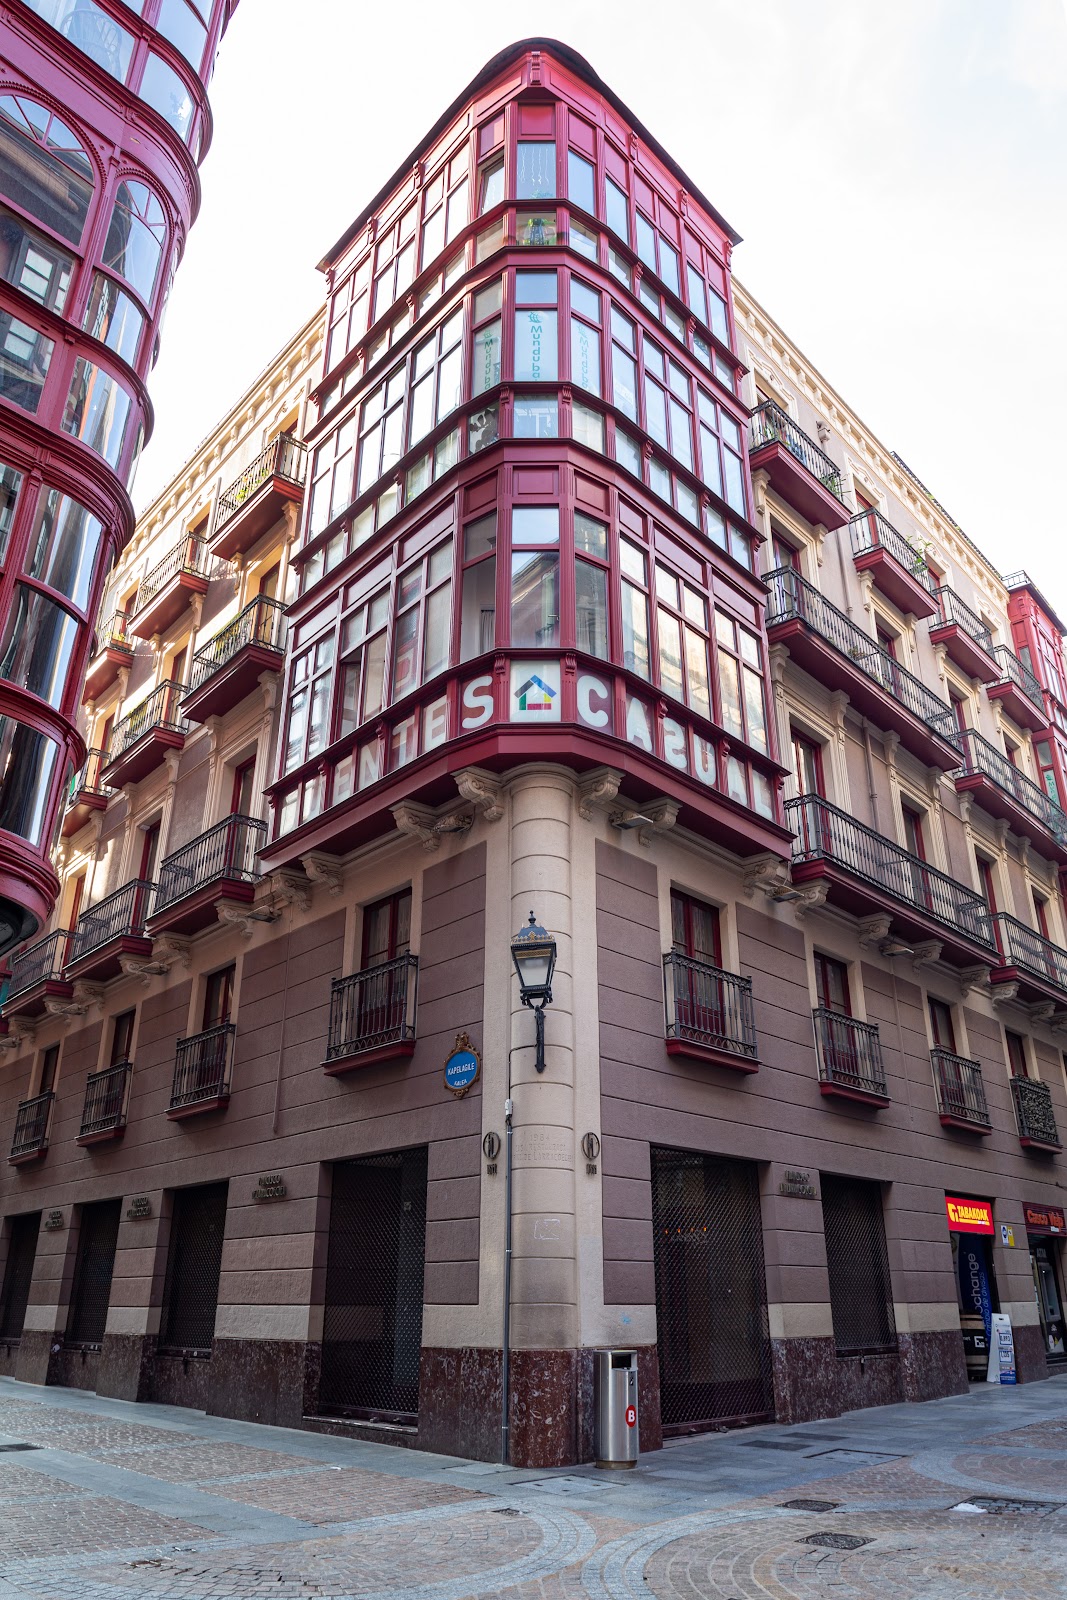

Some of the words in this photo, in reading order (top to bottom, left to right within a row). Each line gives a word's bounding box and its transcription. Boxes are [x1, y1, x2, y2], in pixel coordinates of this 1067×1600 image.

[530, 325, 543, 381] Munduba
[447, 1062, 475, 1076] KAPELAGILE
[956, 1205, 989, 1221] TABAKOAK
[1027, 1209, 1048, 1225] Casco
[628, 1409, 636, 1423] B
